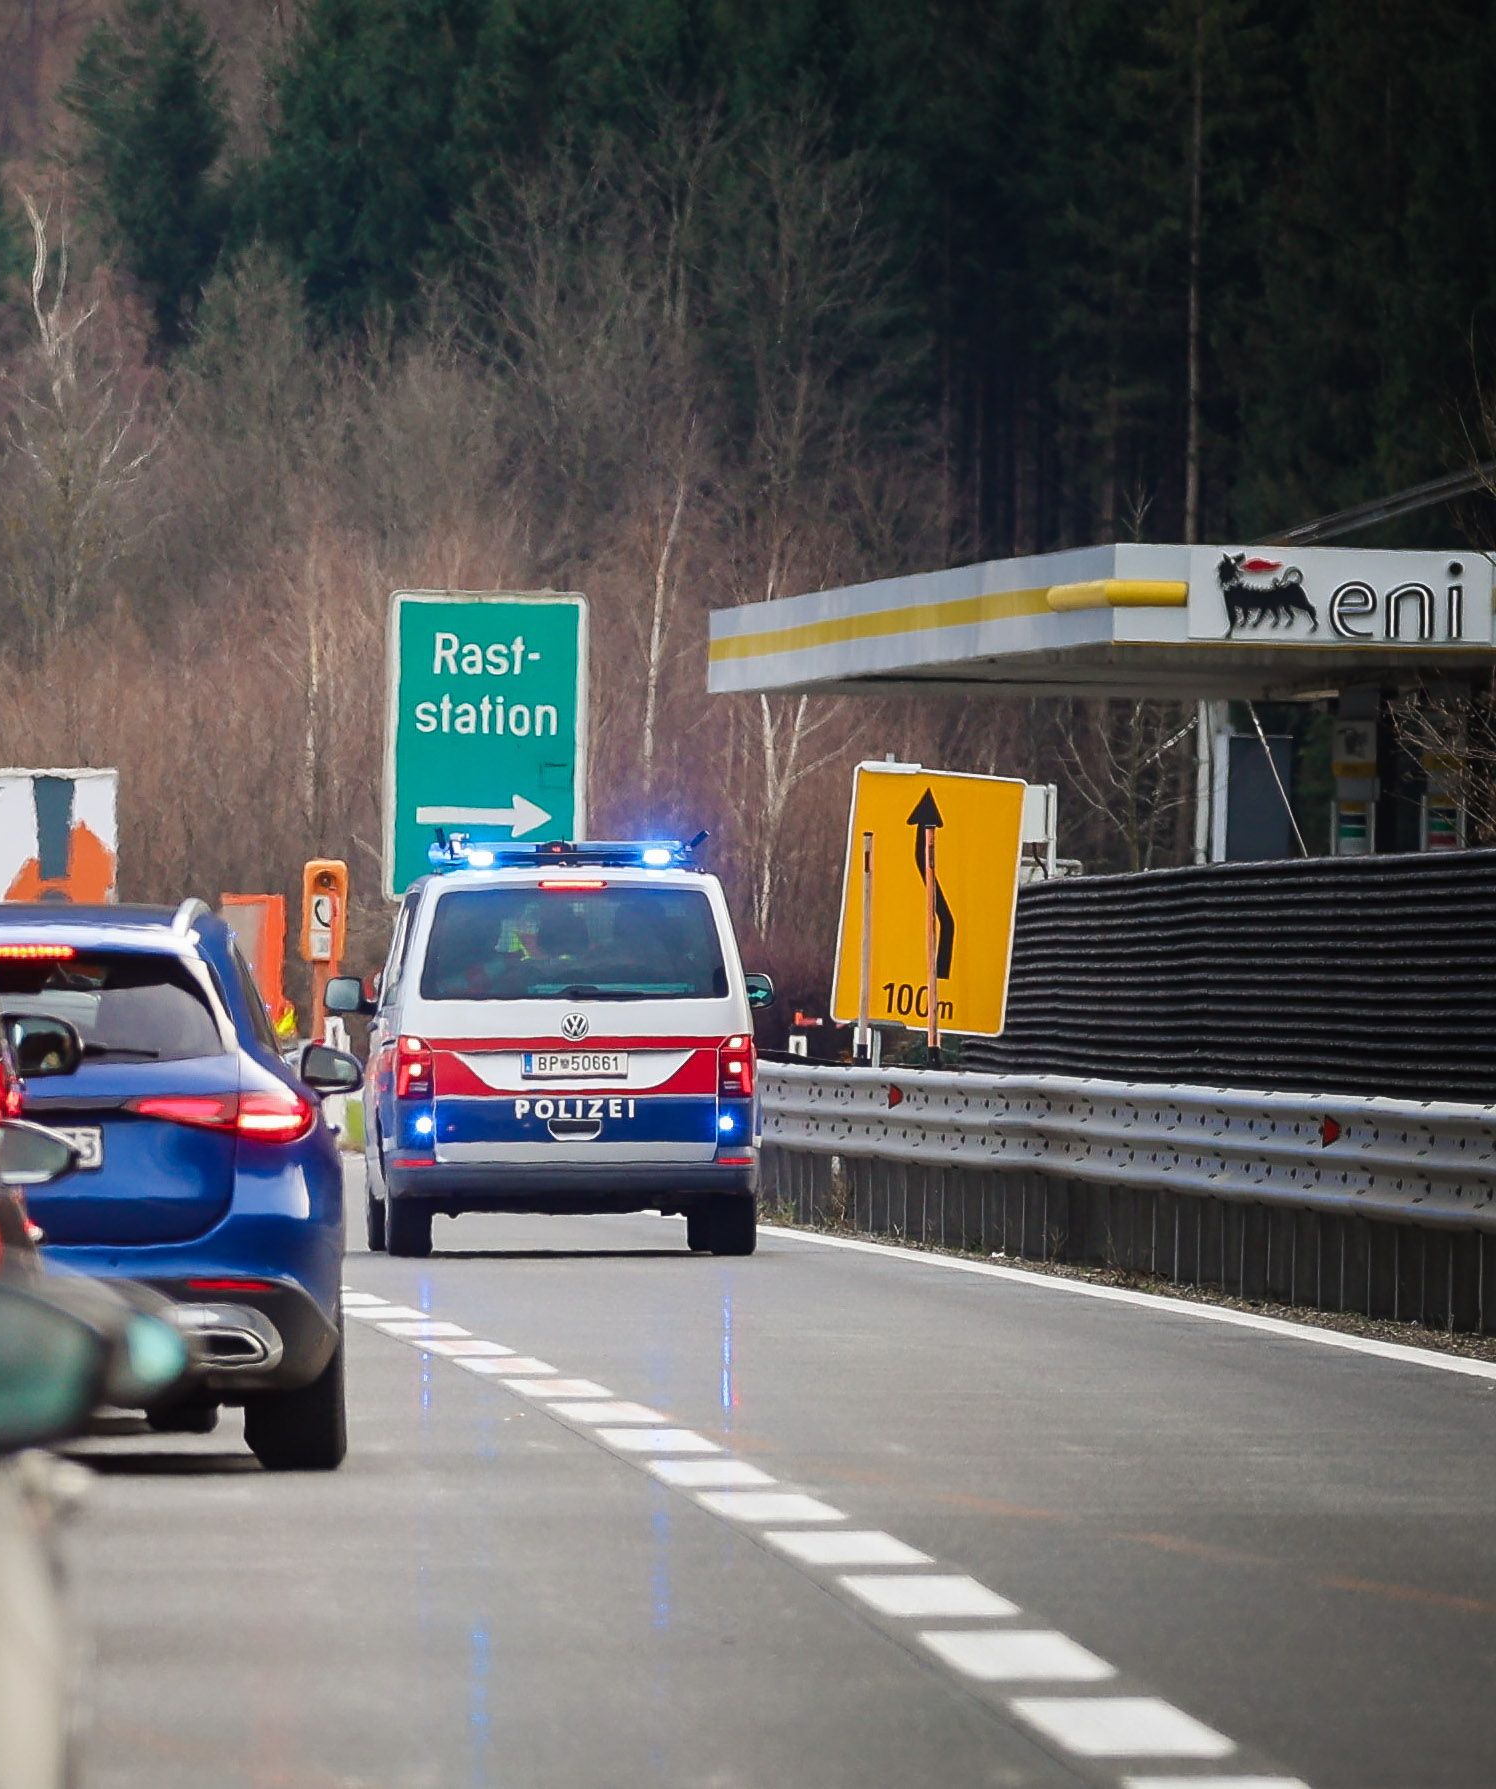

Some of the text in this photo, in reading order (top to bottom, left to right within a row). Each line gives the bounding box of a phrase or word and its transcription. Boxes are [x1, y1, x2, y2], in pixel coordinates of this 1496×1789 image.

[1329, 560, 1464, 640] eni
[432, 631, 541, 676] Rast-
[414, 694, 559, 737] station
[538, 1055, 619, 1072] BP 50661
[514, 1098, 636, 1120] POLIZEI
